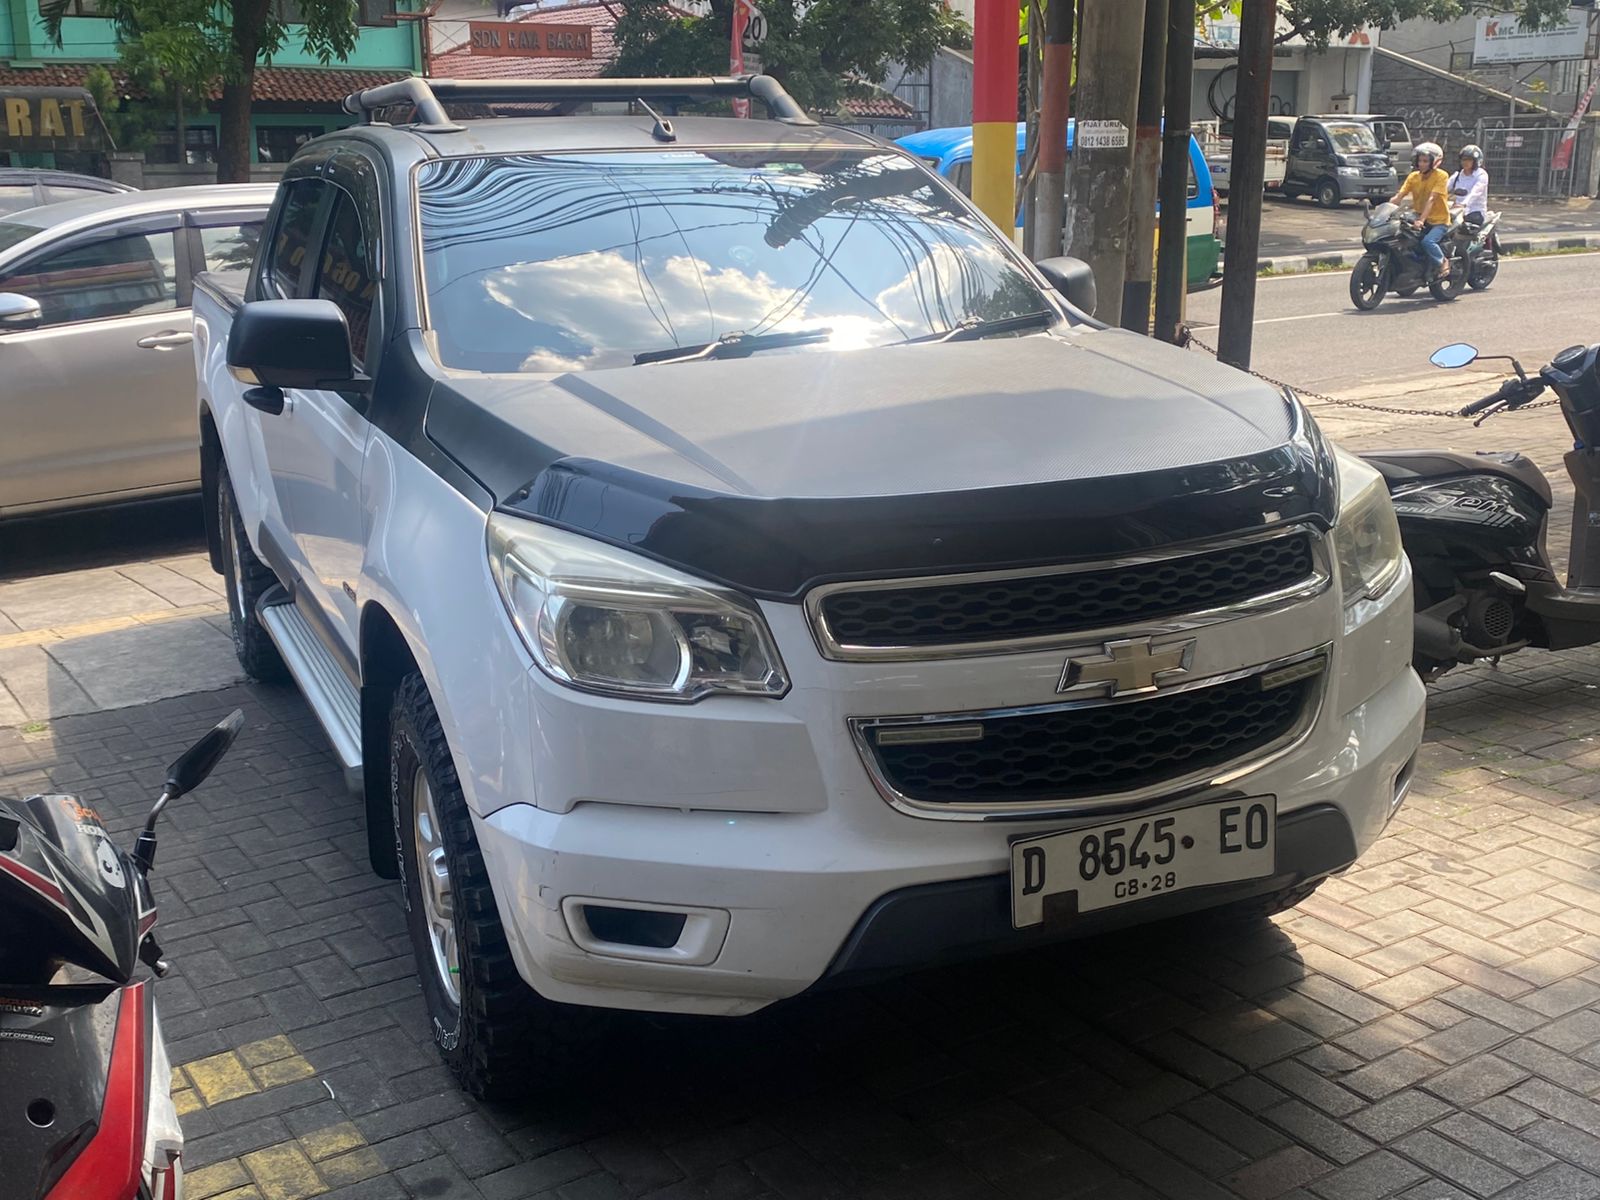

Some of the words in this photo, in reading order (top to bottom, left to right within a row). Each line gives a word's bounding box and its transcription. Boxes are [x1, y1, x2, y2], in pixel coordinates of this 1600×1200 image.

[472, 30, 500, 49] SDN
[1022, 846, 1046, 896] D
[1079, 816, 1176, 882] 8545
[1220, 803, 1268, 854] EO
